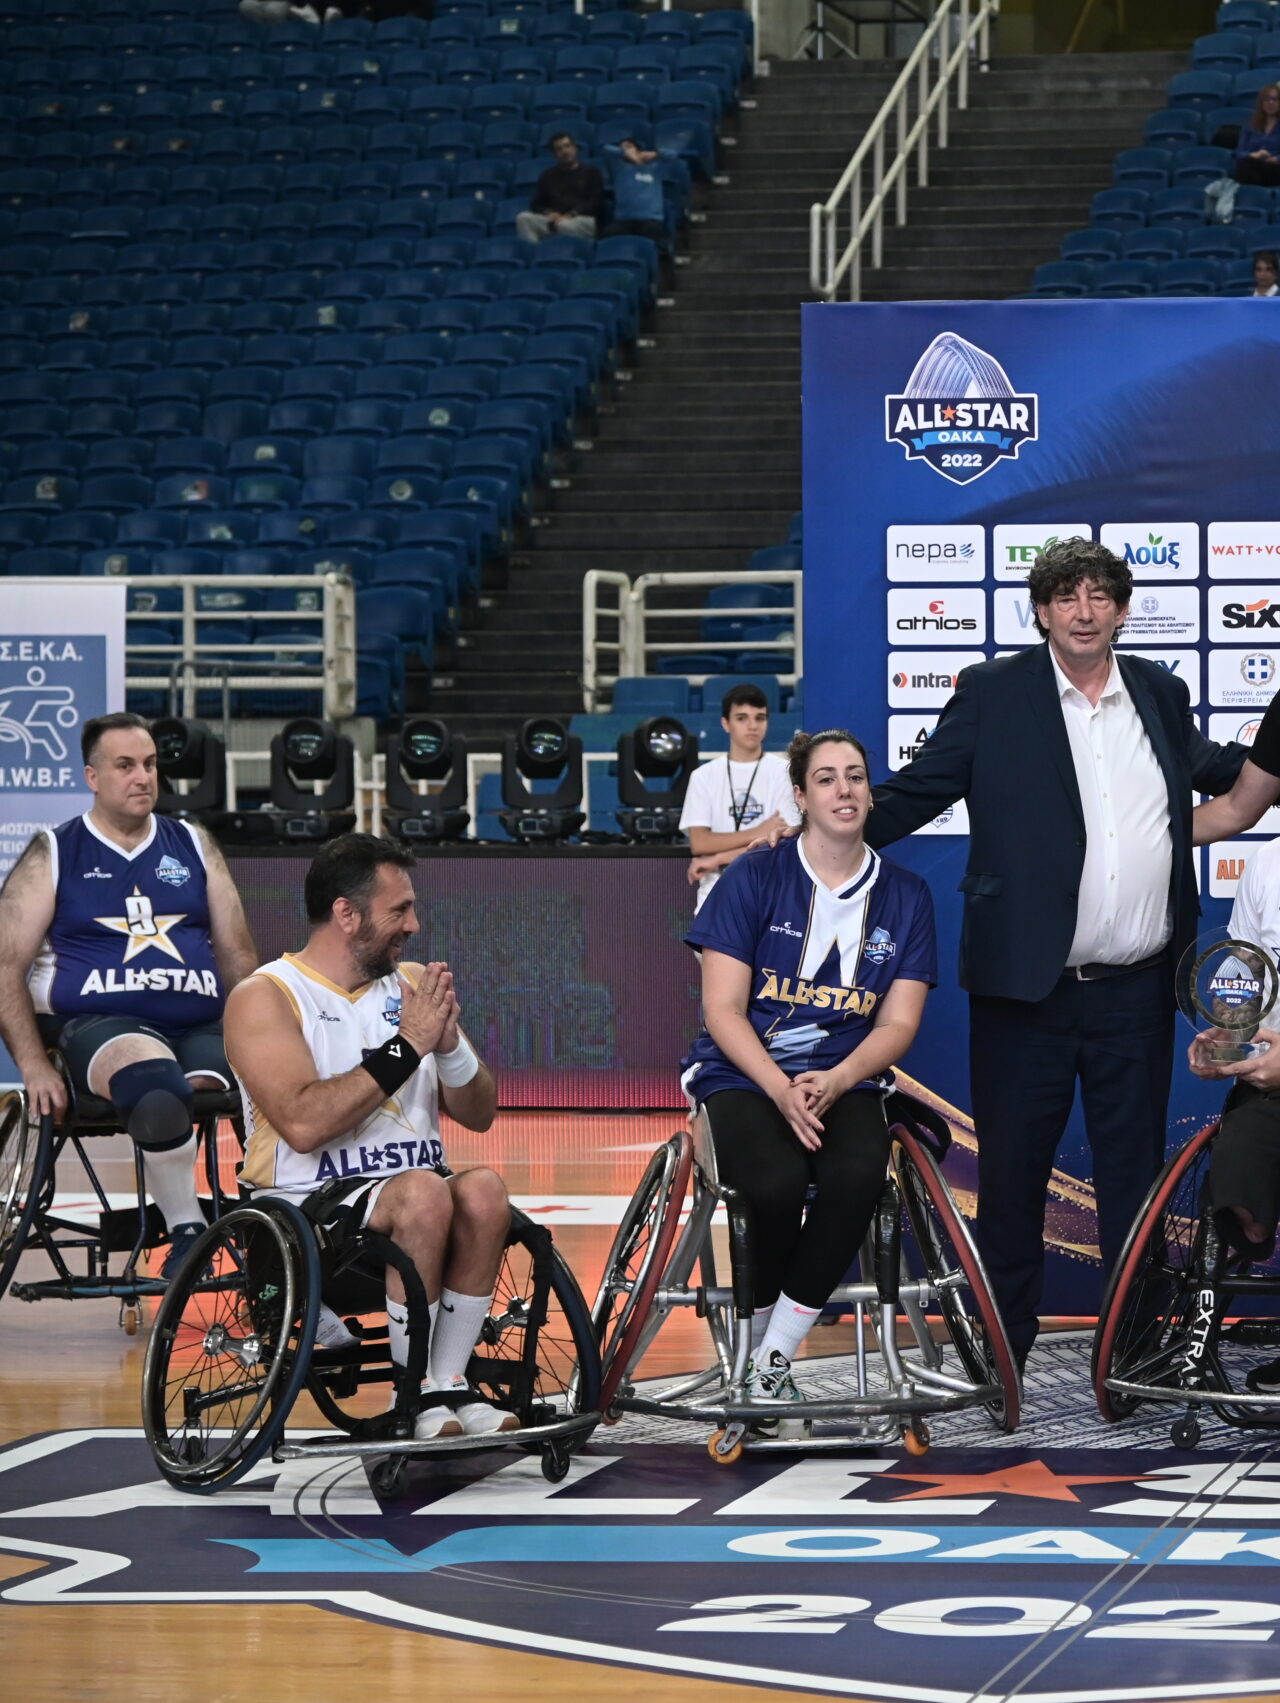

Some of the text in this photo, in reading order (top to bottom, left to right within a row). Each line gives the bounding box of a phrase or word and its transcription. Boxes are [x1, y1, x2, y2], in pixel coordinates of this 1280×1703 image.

[937, 431, 985, 443] OAKA
[941, 454, 983, 467] 2022
[125, 895, 158, 936] 9
[1184, 1289, 1214, 1370] EXTRA
